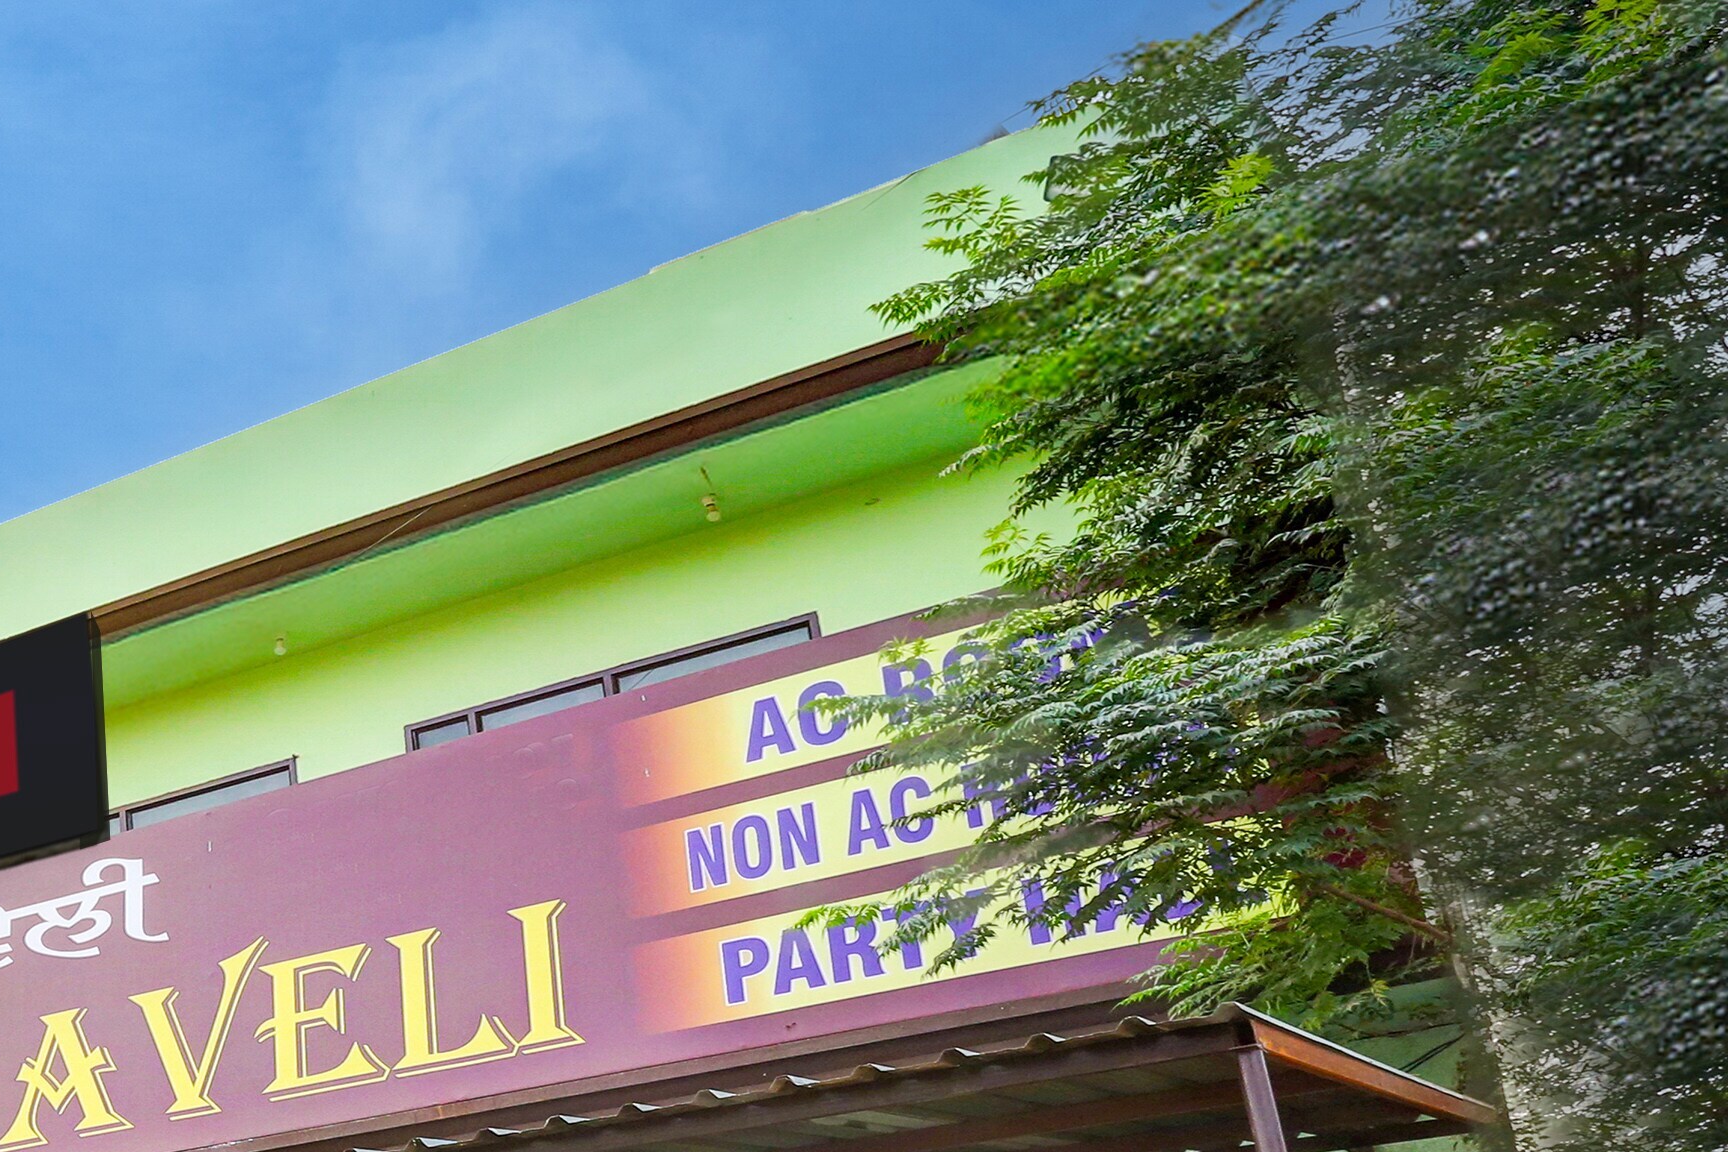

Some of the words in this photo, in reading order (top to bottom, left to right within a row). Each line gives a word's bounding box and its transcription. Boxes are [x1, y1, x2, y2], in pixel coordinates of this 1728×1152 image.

[746, 679, 848, 764] AC
[684, 801, 821, 892] NON
[847, 776, 934, 856] AC
